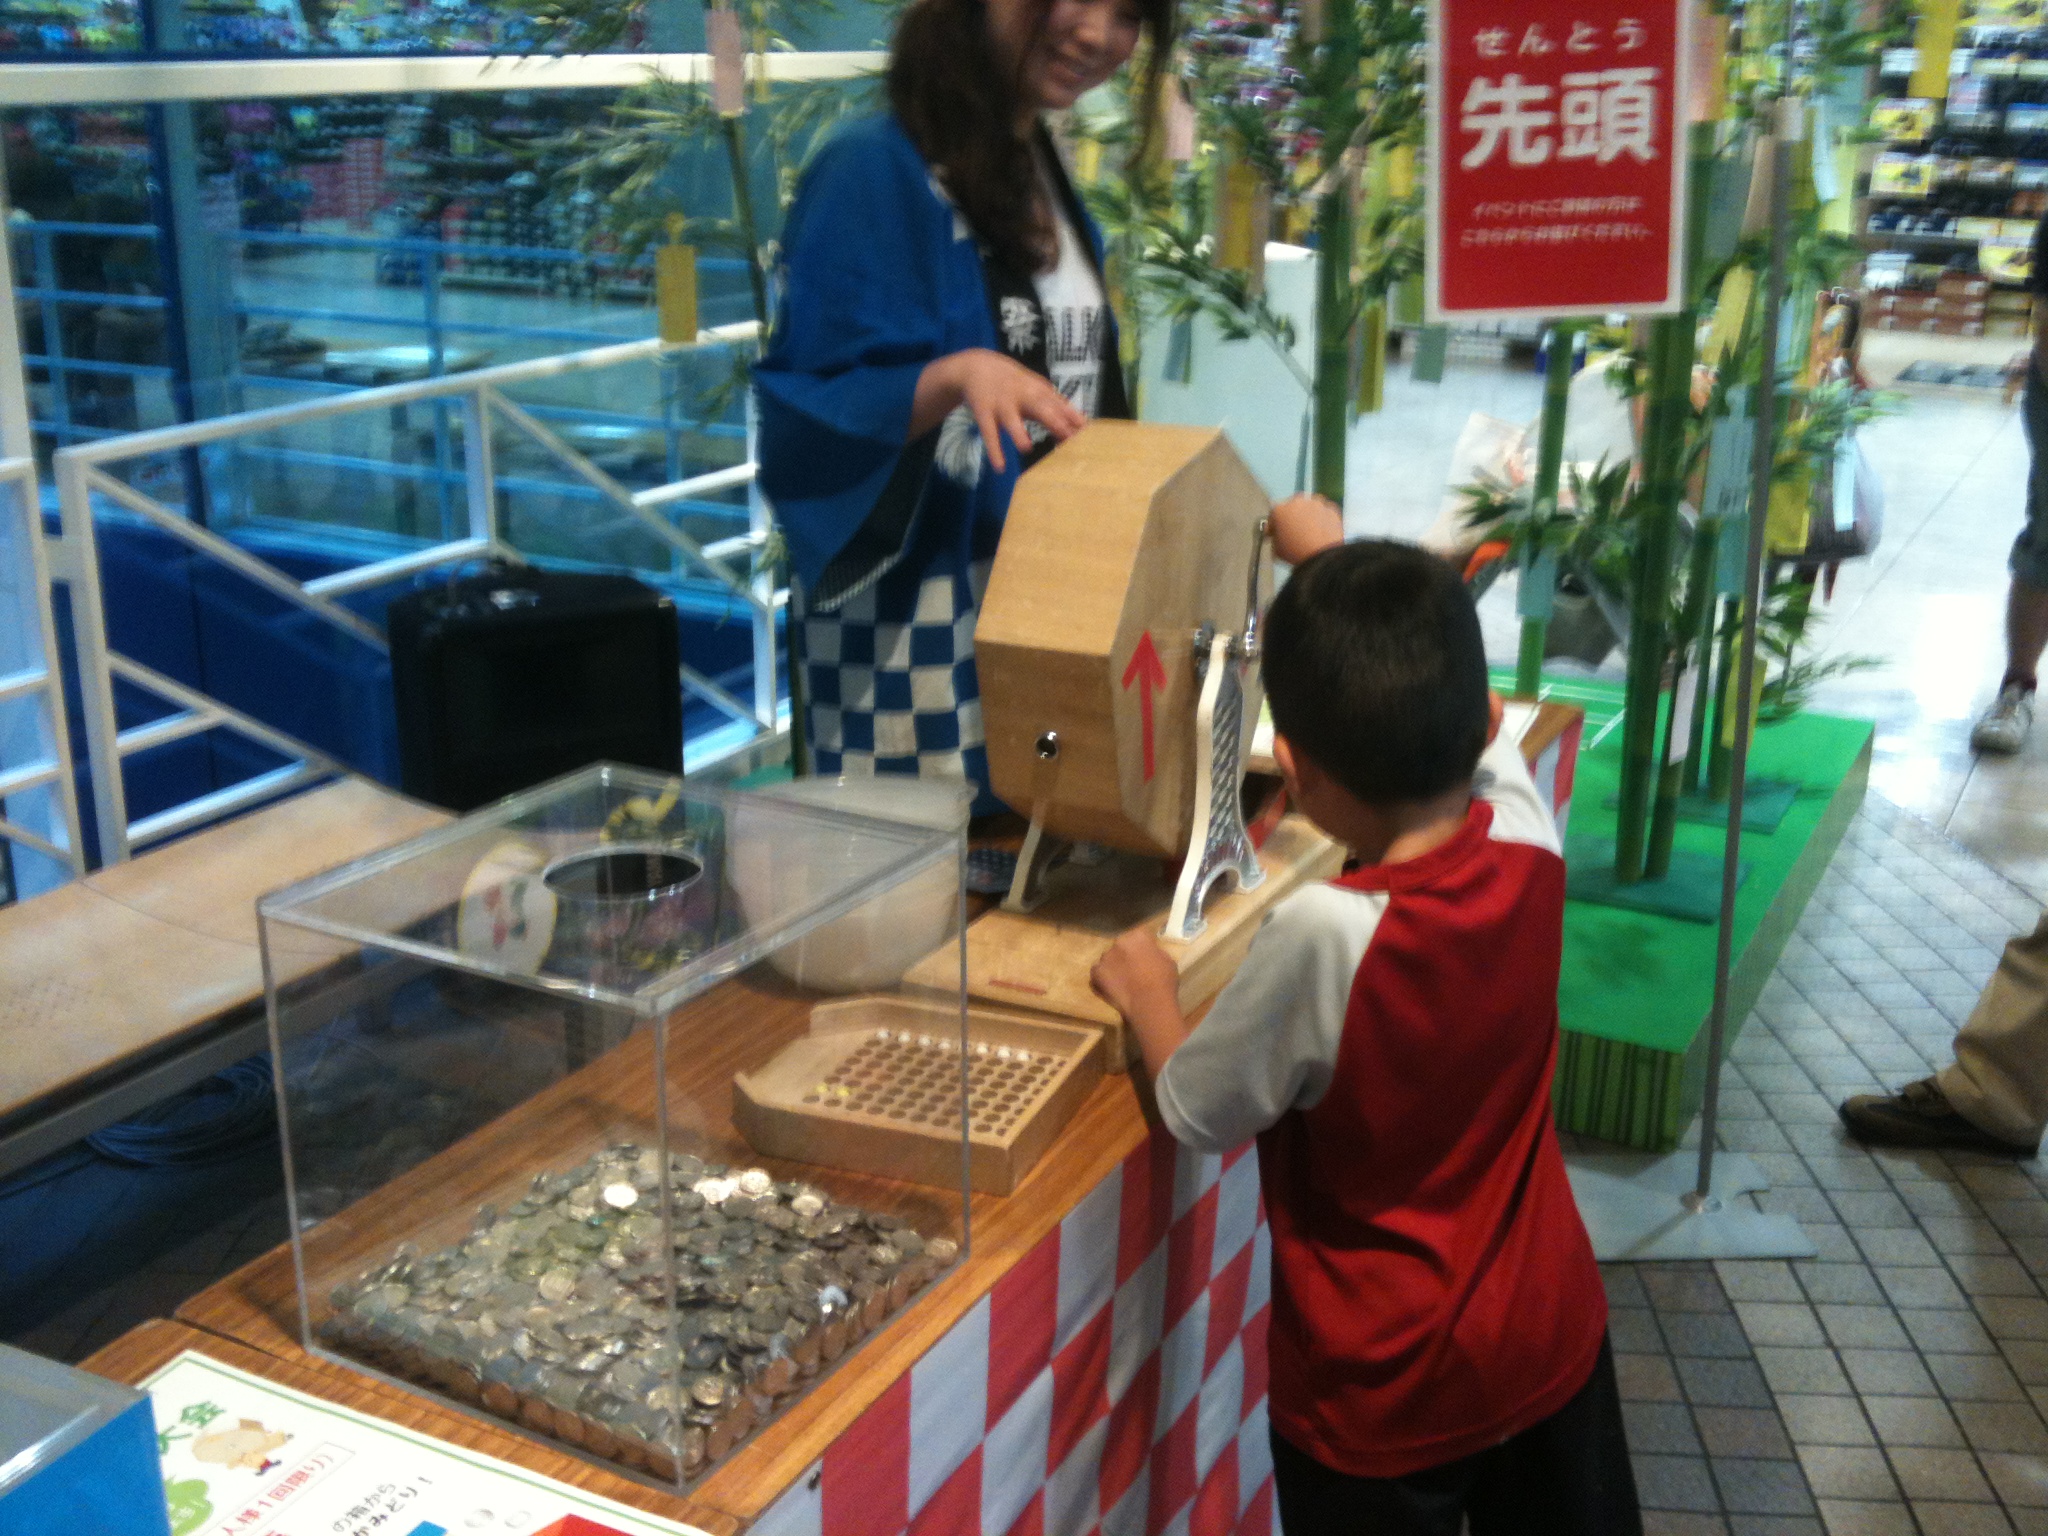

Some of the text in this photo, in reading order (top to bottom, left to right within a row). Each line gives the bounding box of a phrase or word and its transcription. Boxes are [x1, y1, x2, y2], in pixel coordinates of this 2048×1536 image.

[1472, 17, 1648, 57] せんとう
[1459, 66, 1660, 170] 先頭
